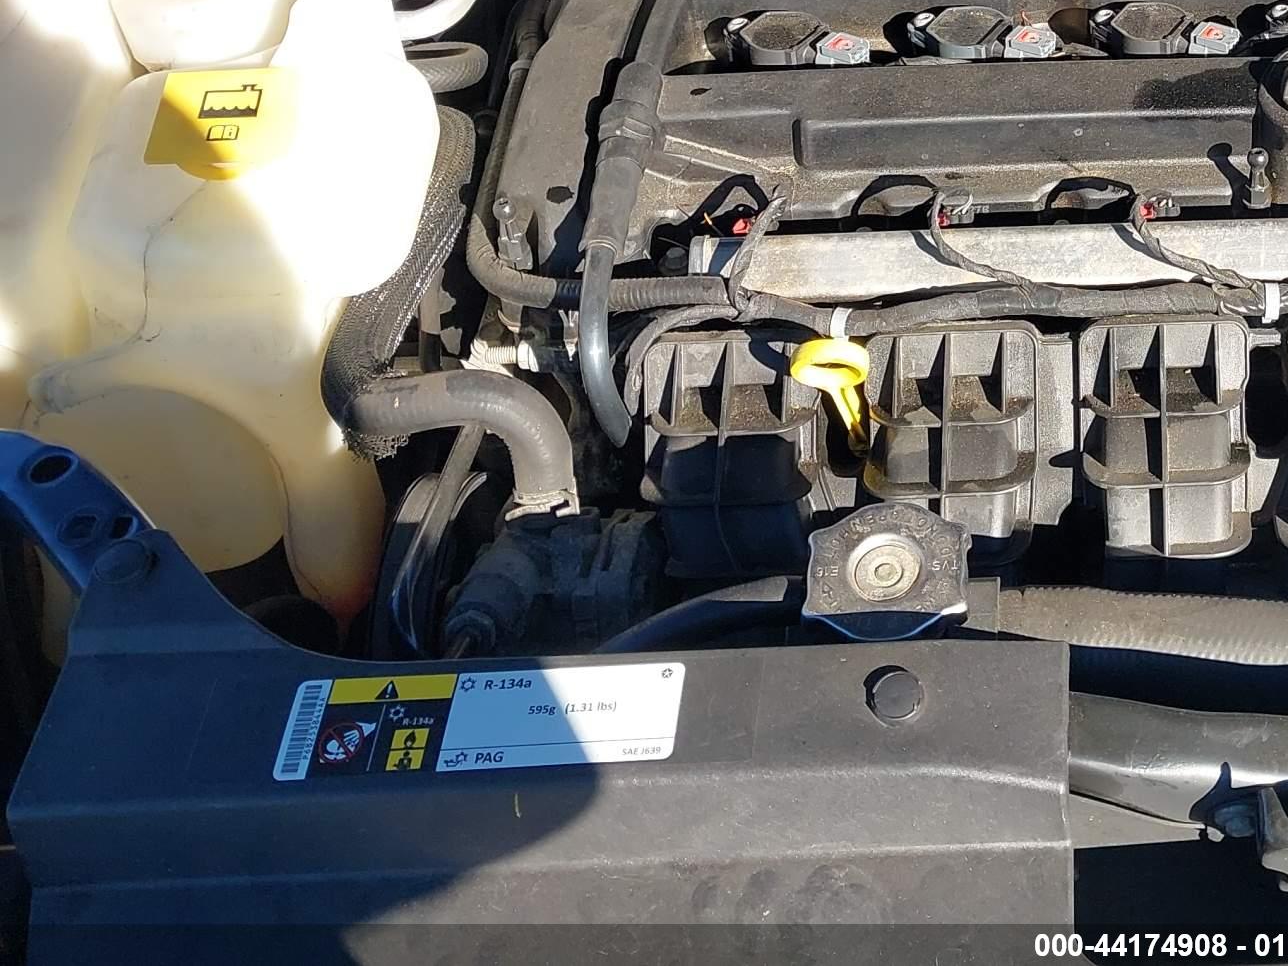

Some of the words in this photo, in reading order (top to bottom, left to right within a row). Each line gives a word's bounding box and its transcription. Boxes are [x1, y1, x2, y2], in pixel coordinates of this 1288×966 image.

[484, 677, 532, 691] R-134a
[528, 705, 556, 716] 595g
[565, 703, 593, 715] (1.31
[597, 701, 617, 713] lbs)
[402, 716, 434, 726] R-134a
[474, 751, 504, 764] PAG
[622, 747, 639, 756] SAE
[641, 746, 661, 755] J639
